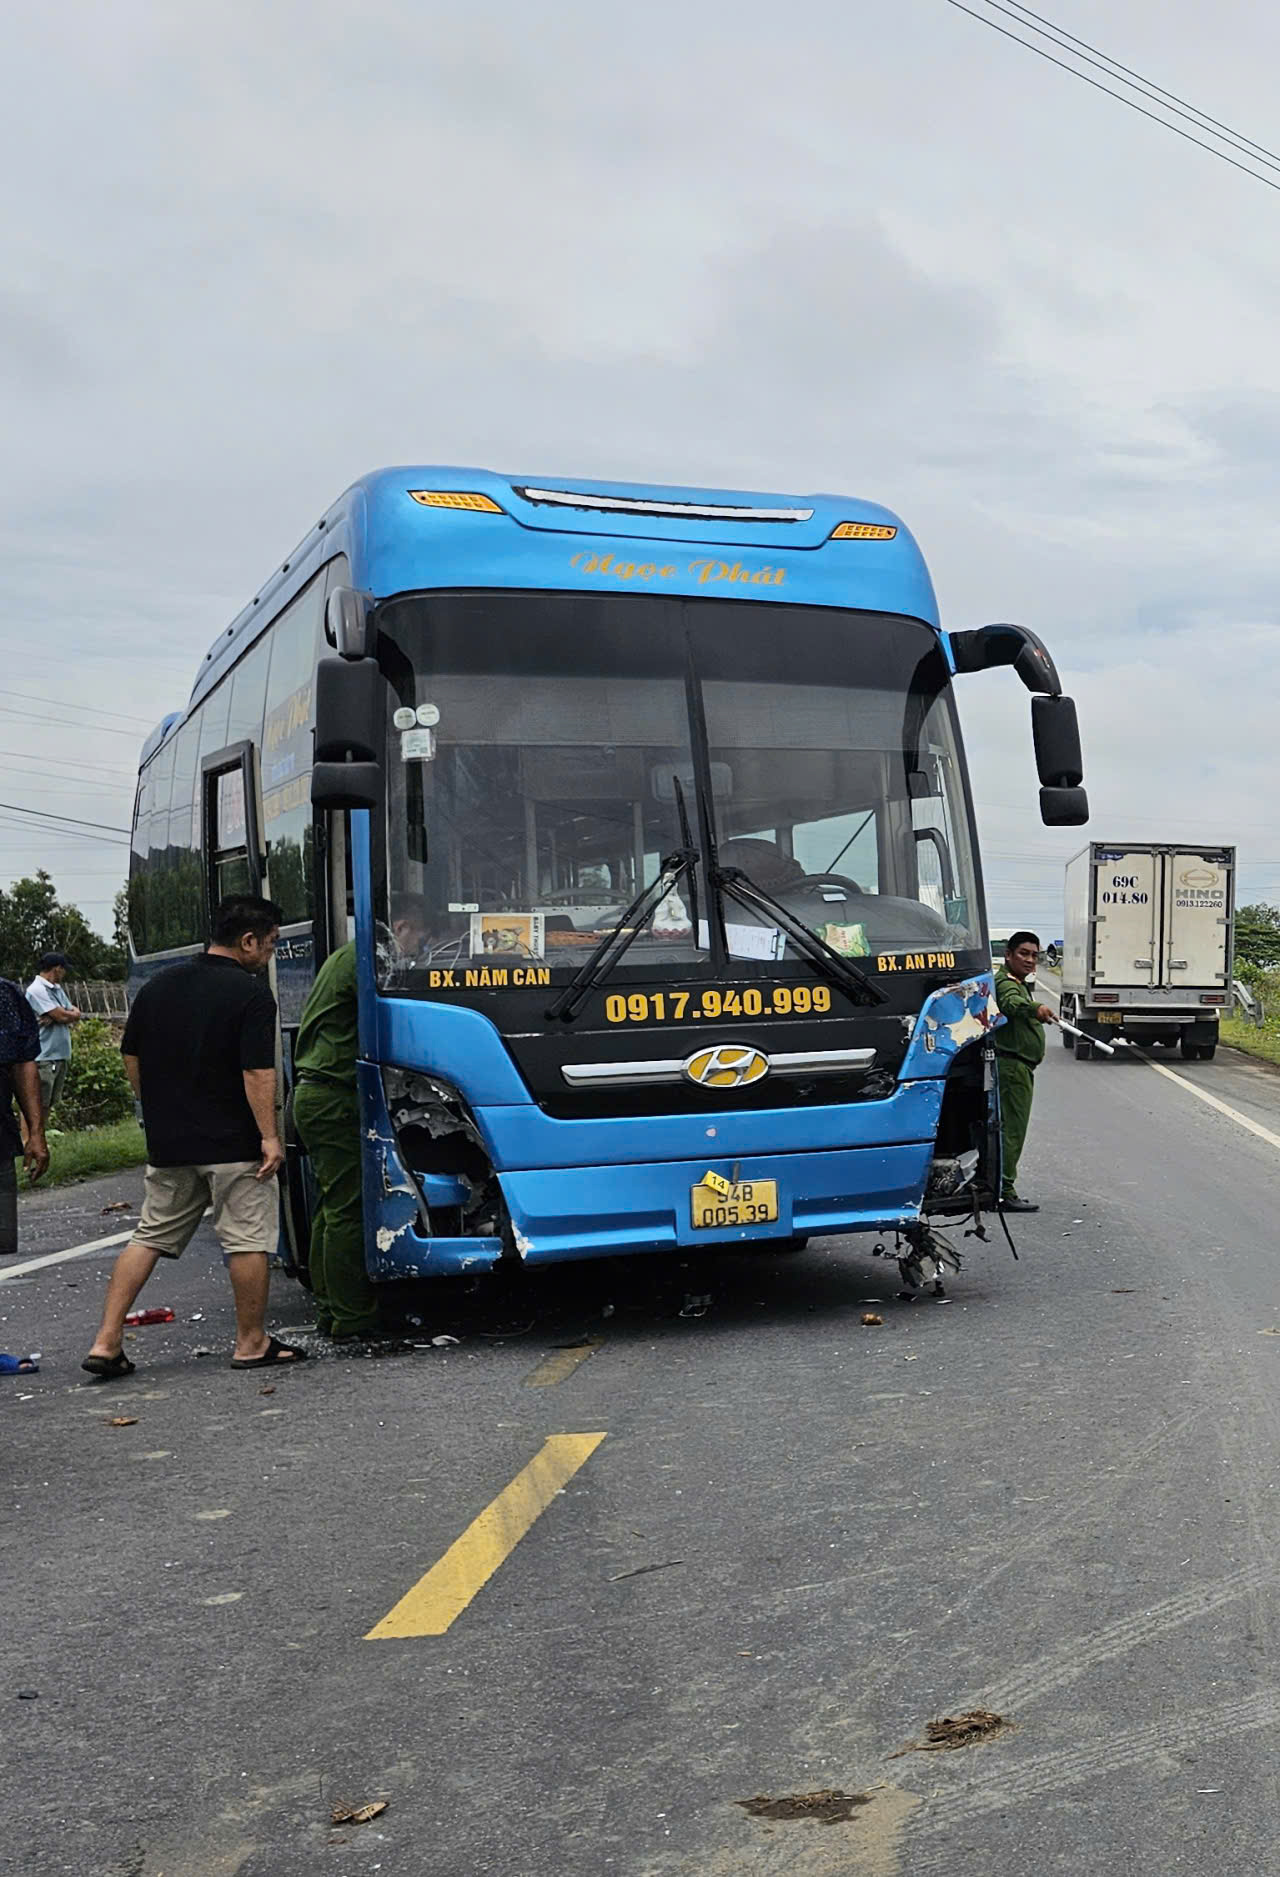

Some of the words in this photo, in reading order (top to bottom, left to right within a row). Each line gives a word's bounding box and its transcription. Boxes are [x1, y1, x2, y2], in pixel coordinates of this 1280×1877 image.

[570, 552, 678, 582] Ngọc
[688, 559, 787, 586] Phát
[1112, 875, 1139, 888] 69C
[1102, 892, 1148, 904] 014.80
[1175, 889, 1224, 900] HINO
[877, 954, 902, 972] BX.
[905, 953, 925, 970] AN
[429, 970, 460, 988] BX.
[465, 965, 508, 986] NĂM
[605, 986, 832, 1023] 0917.940.999
[711, 1175, 725, 1189] 14
[702, 1203, 769, 1226] 005.39
